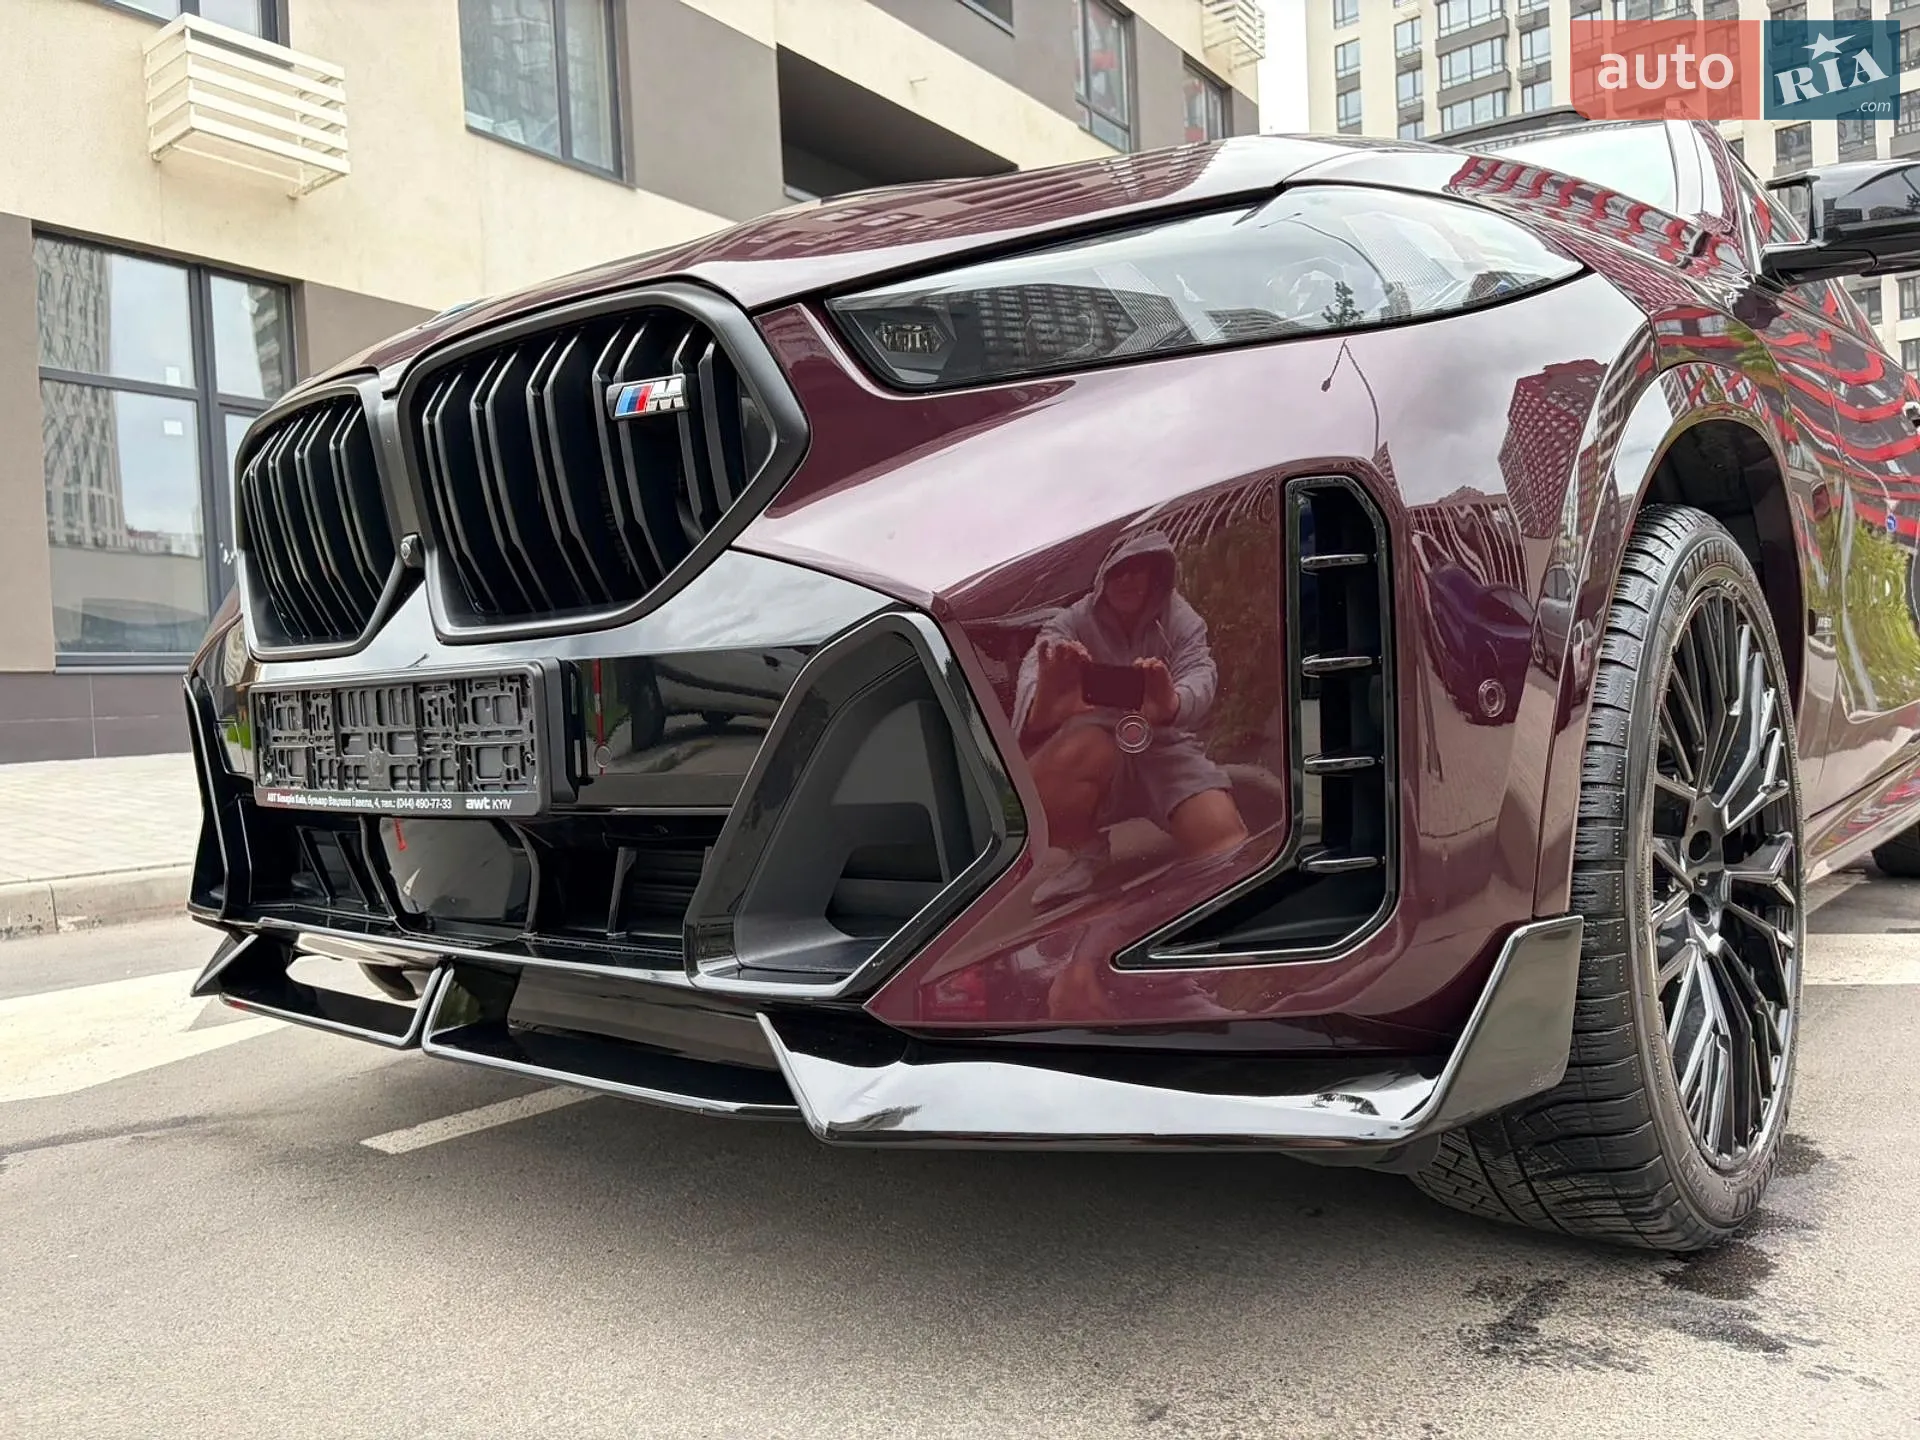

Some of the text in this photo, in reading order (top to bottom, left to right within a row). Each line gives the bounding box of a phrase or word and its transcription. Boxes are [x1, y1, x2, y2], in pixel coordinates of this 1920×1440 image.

[646, 378, 685, 411] M
[465, 796, 512, 810] awt KYIV
